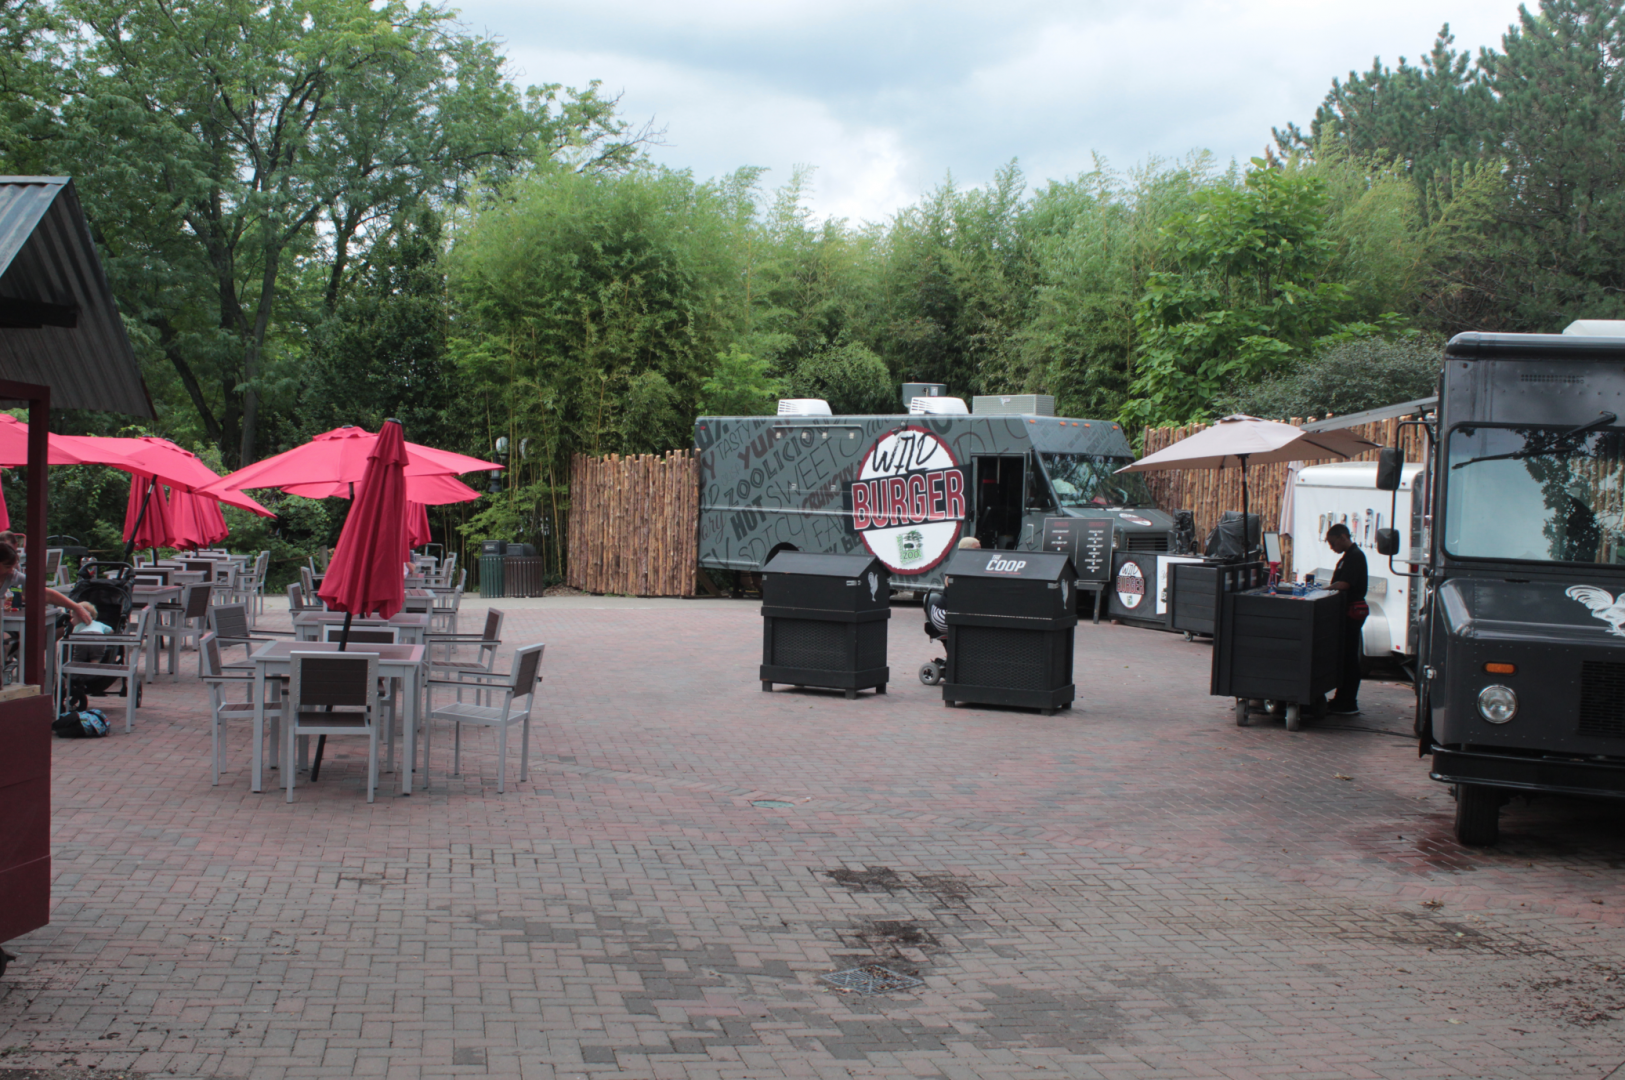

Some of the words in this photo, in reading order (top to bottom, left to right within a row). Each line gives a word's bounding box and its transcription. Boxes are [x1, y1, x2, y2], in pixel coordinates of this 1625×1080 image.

[716, 420, 751, 460] TASTY
[873, 431, 938, 475] WILD
[730, 495, 767, 542] HOT
[852, 469, 965, 530] BURGER
[903, 551, 919, 560] ZOO
[985, 560, 1027, 572] COOP
[1116, 575, 1144, 595] BURGER
